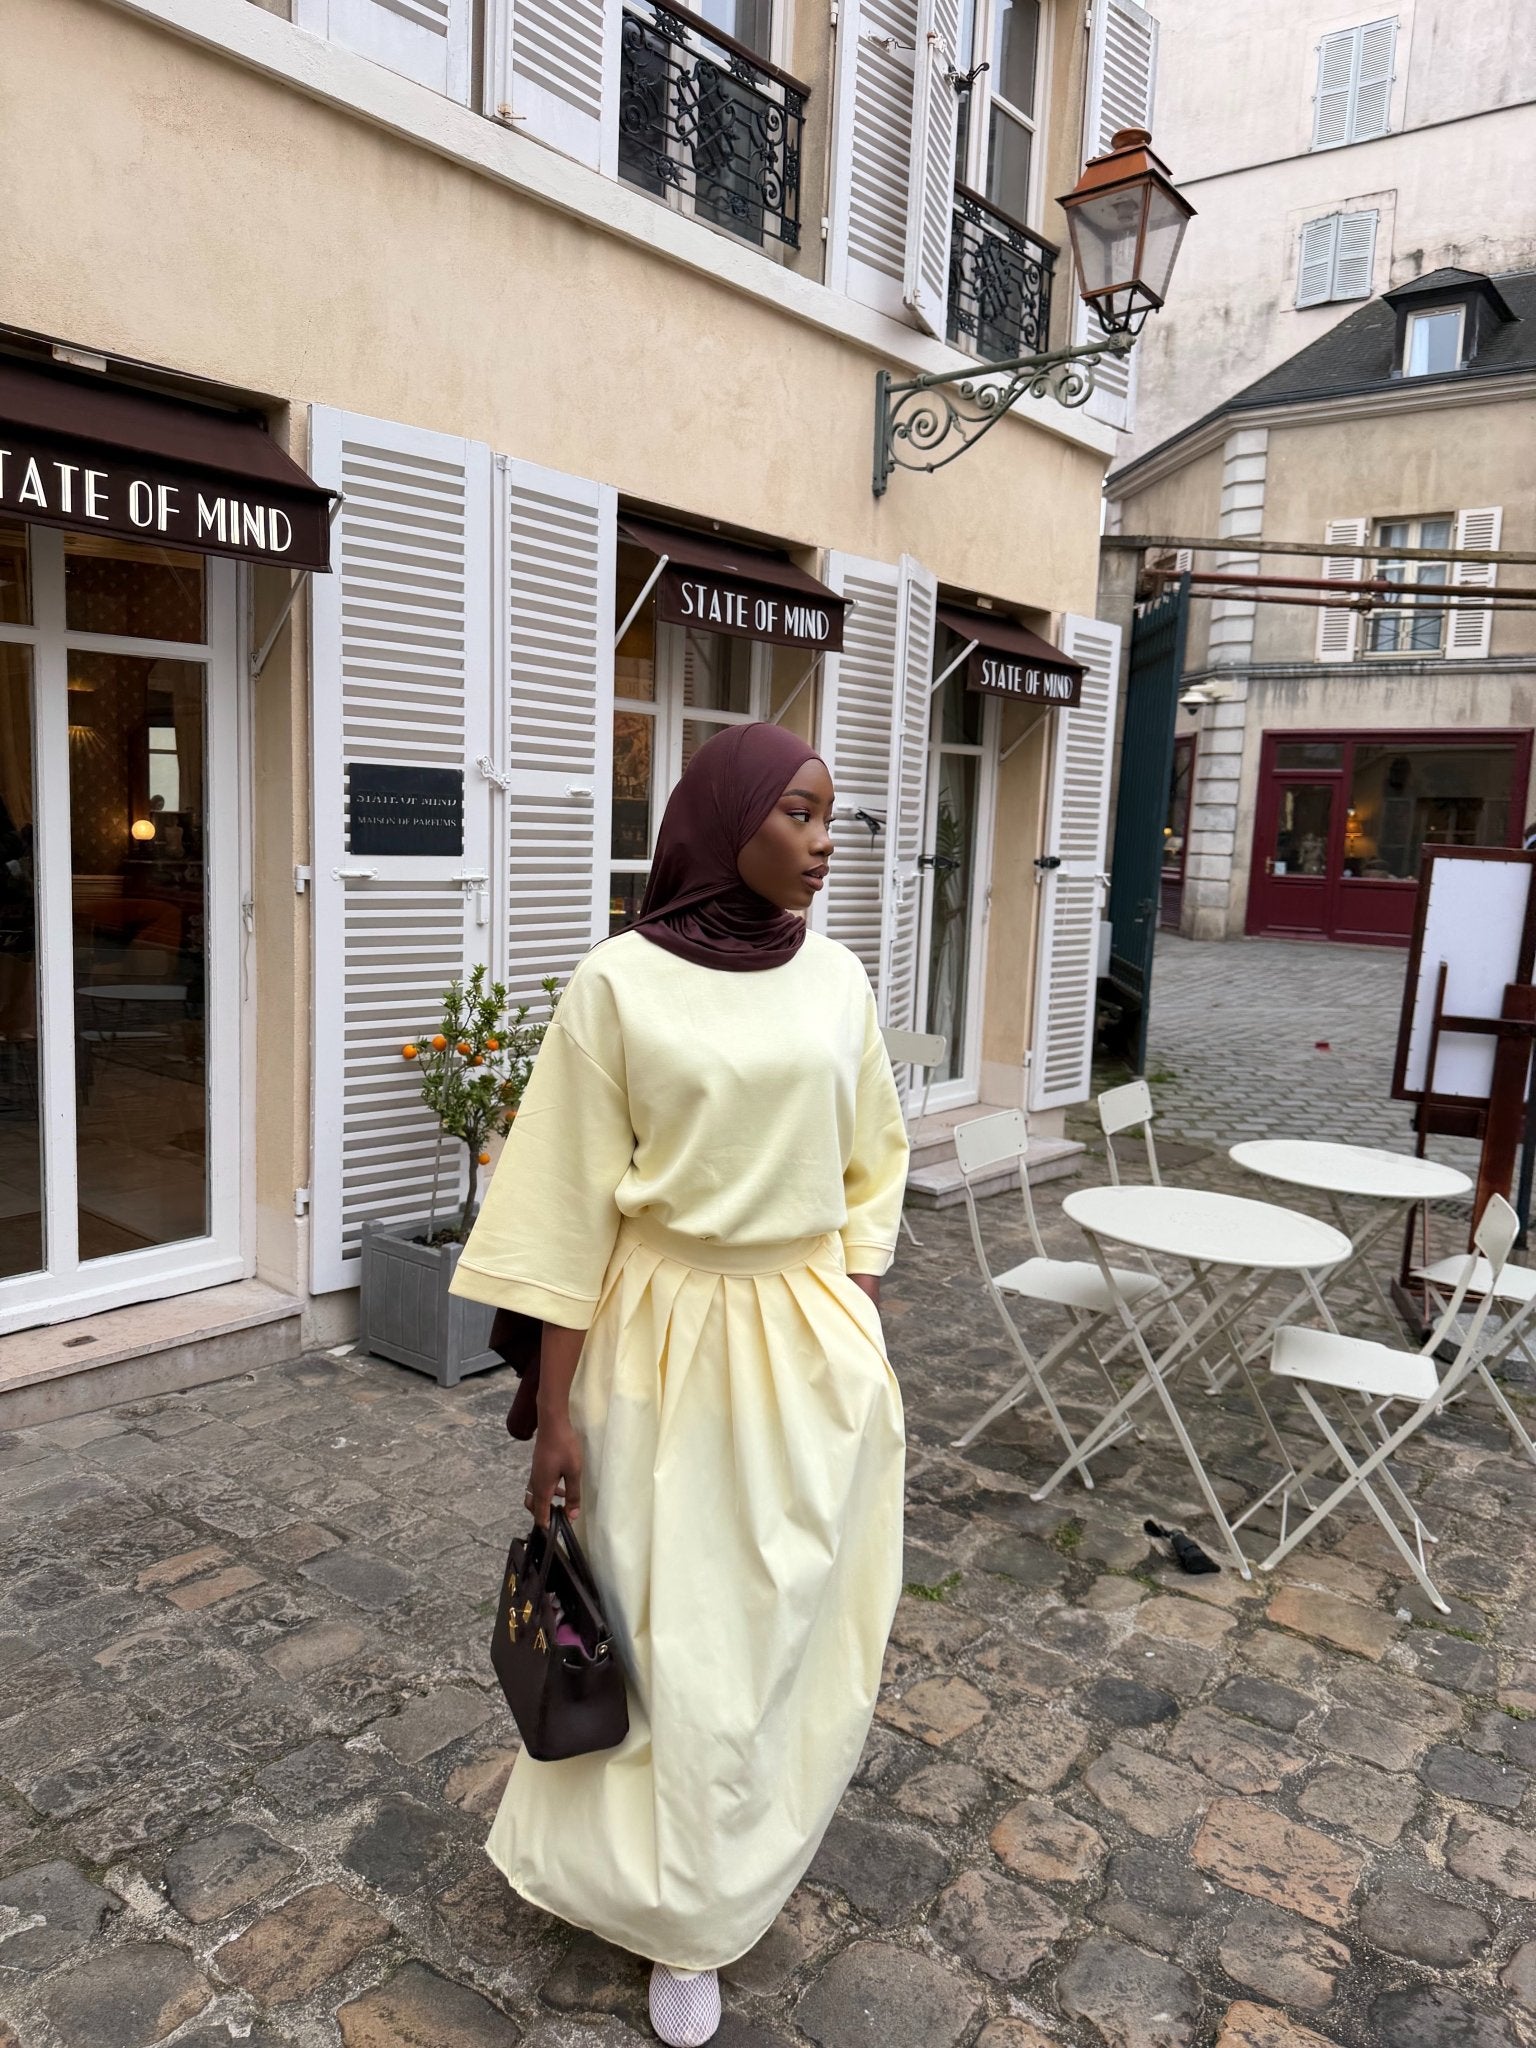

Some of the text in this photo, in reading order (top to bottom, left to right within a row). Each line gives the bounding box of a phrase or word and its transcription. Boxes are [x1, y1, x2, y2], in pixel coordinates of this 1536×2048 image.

[129, 480, 180, 532] OF
[197, 492, 292, 552] MIND
[680, 582, 830, 641] STATE OF MIND
[980, 659, 1073, 700] STATE OF MIND
[356, 795, 457, 806] STATE OF MIND
[358, 816, 396, 825] MAISON
[398, 817, 411, 825] DE
